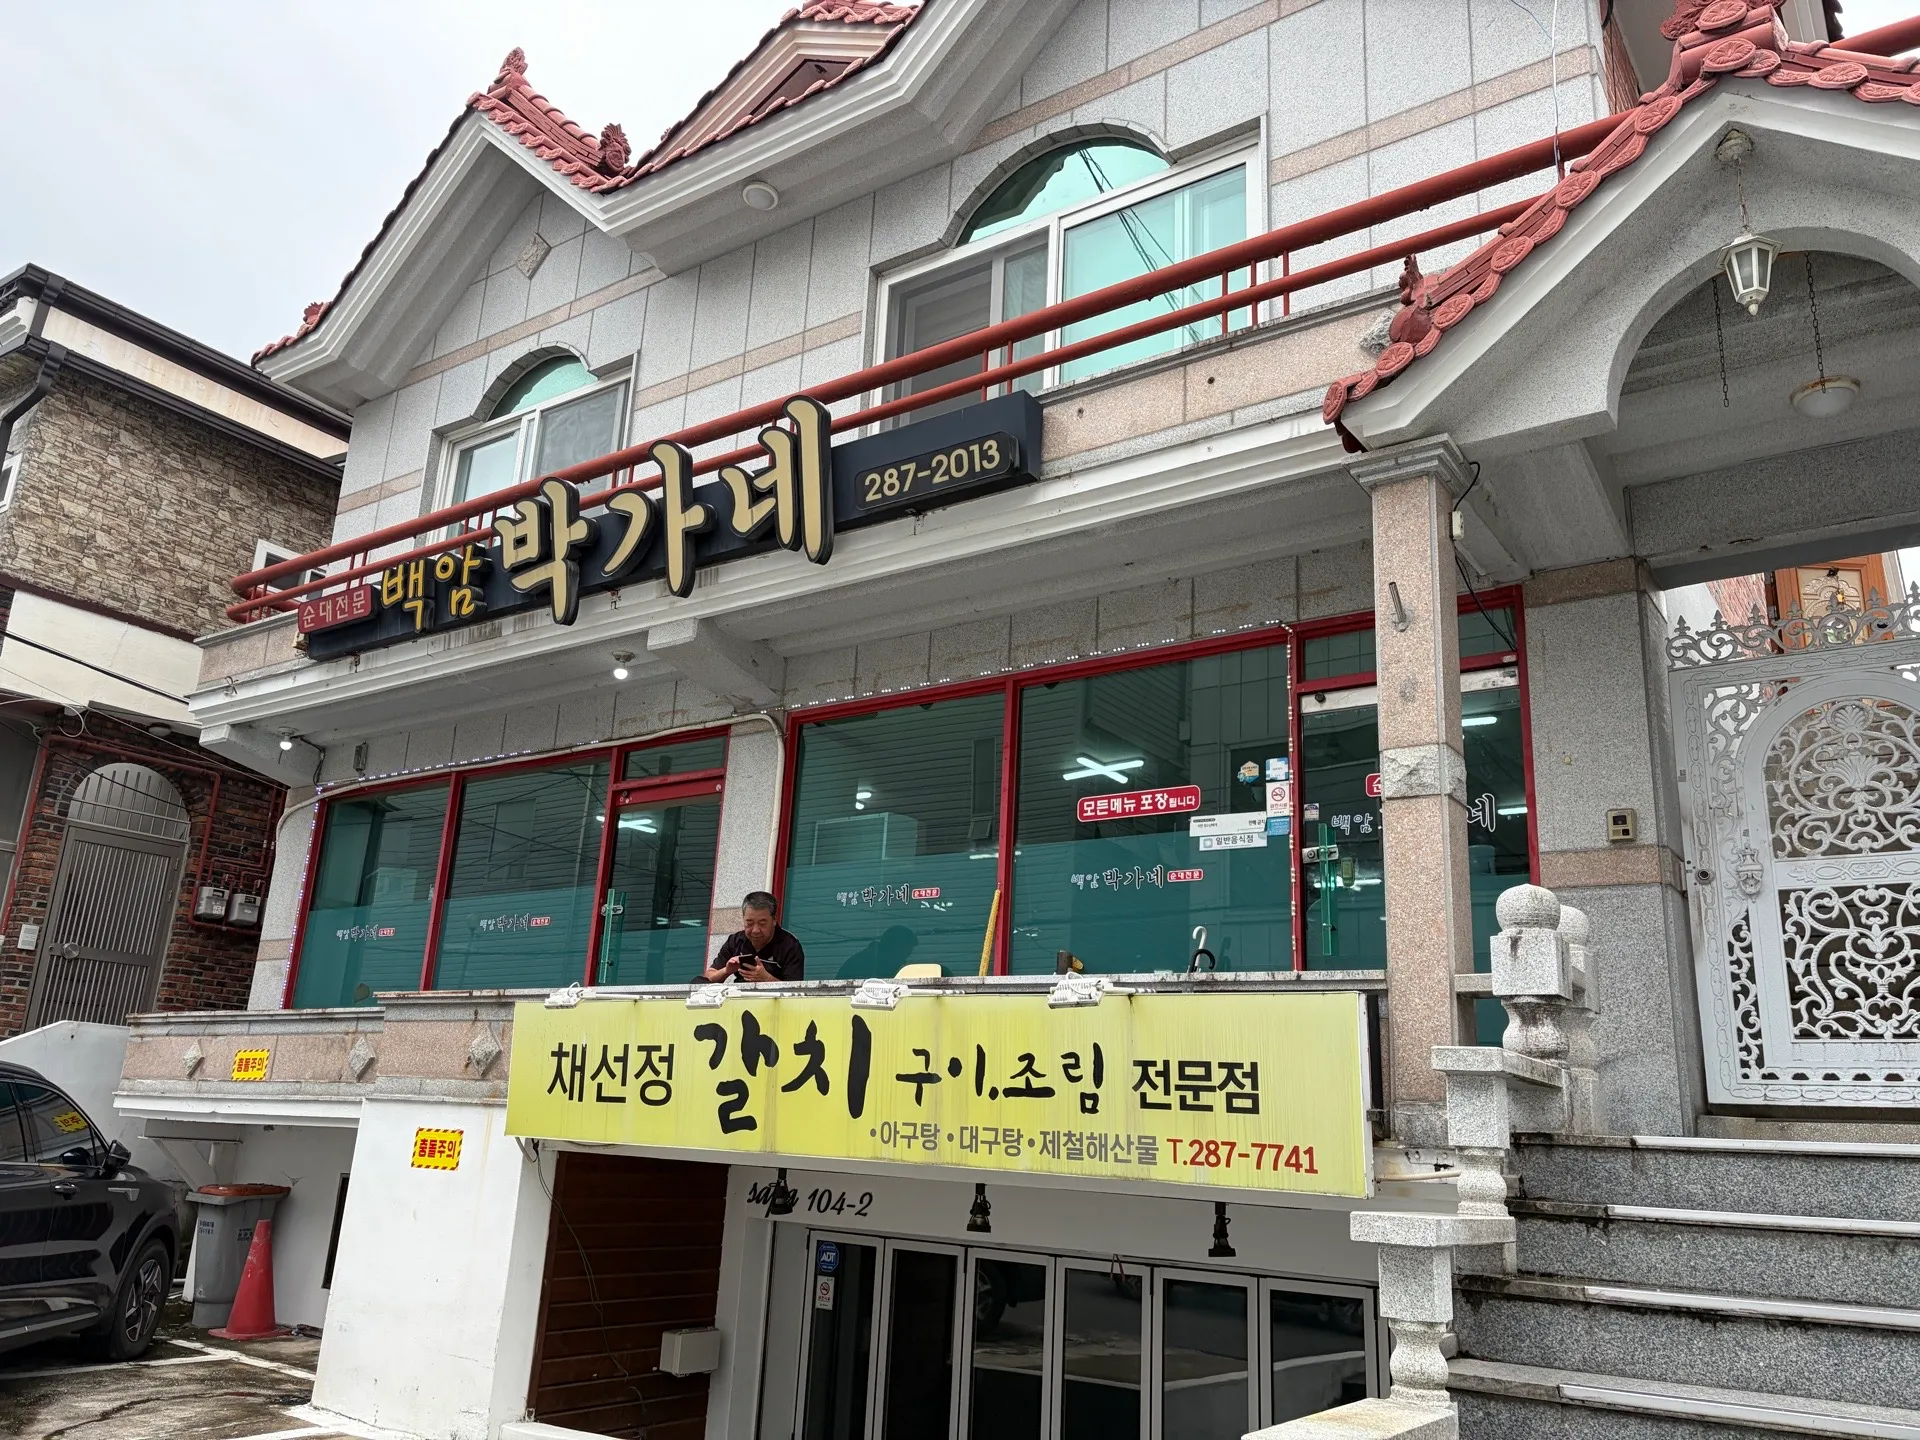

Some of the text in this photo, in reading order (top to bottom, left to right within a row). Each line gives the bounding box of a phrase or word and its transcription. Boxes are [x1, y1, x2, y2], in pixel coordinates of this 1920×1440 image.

[864, 439, 1001, 502] 287-2013
[302, 397, 829, 631] 순대전문 백암 박가네
[1083, 797, 1136, 817] 모든메뉴
[1331, 813, 1374, 836] 백암
[1102, 864, 1164, 891] 박가네
[861, 883, 910, 907] 박가네
[236, 1057, 266, 1072] 충돌주의
[546, 1042, 675, 1107] 채선정
[694, 1010, 872, 1134] 갈치
[1132, 1059, 1260, 1115] 전문점
[418, 1138, 457, 1159] 충돌주의
[880, 1121, 1319, 1175] 아구탕 대구탕 제철해산물 T.287-7741
[807, 1188, 874, 1217] 104-2
[820, 1251, 836, 1263] ADT
